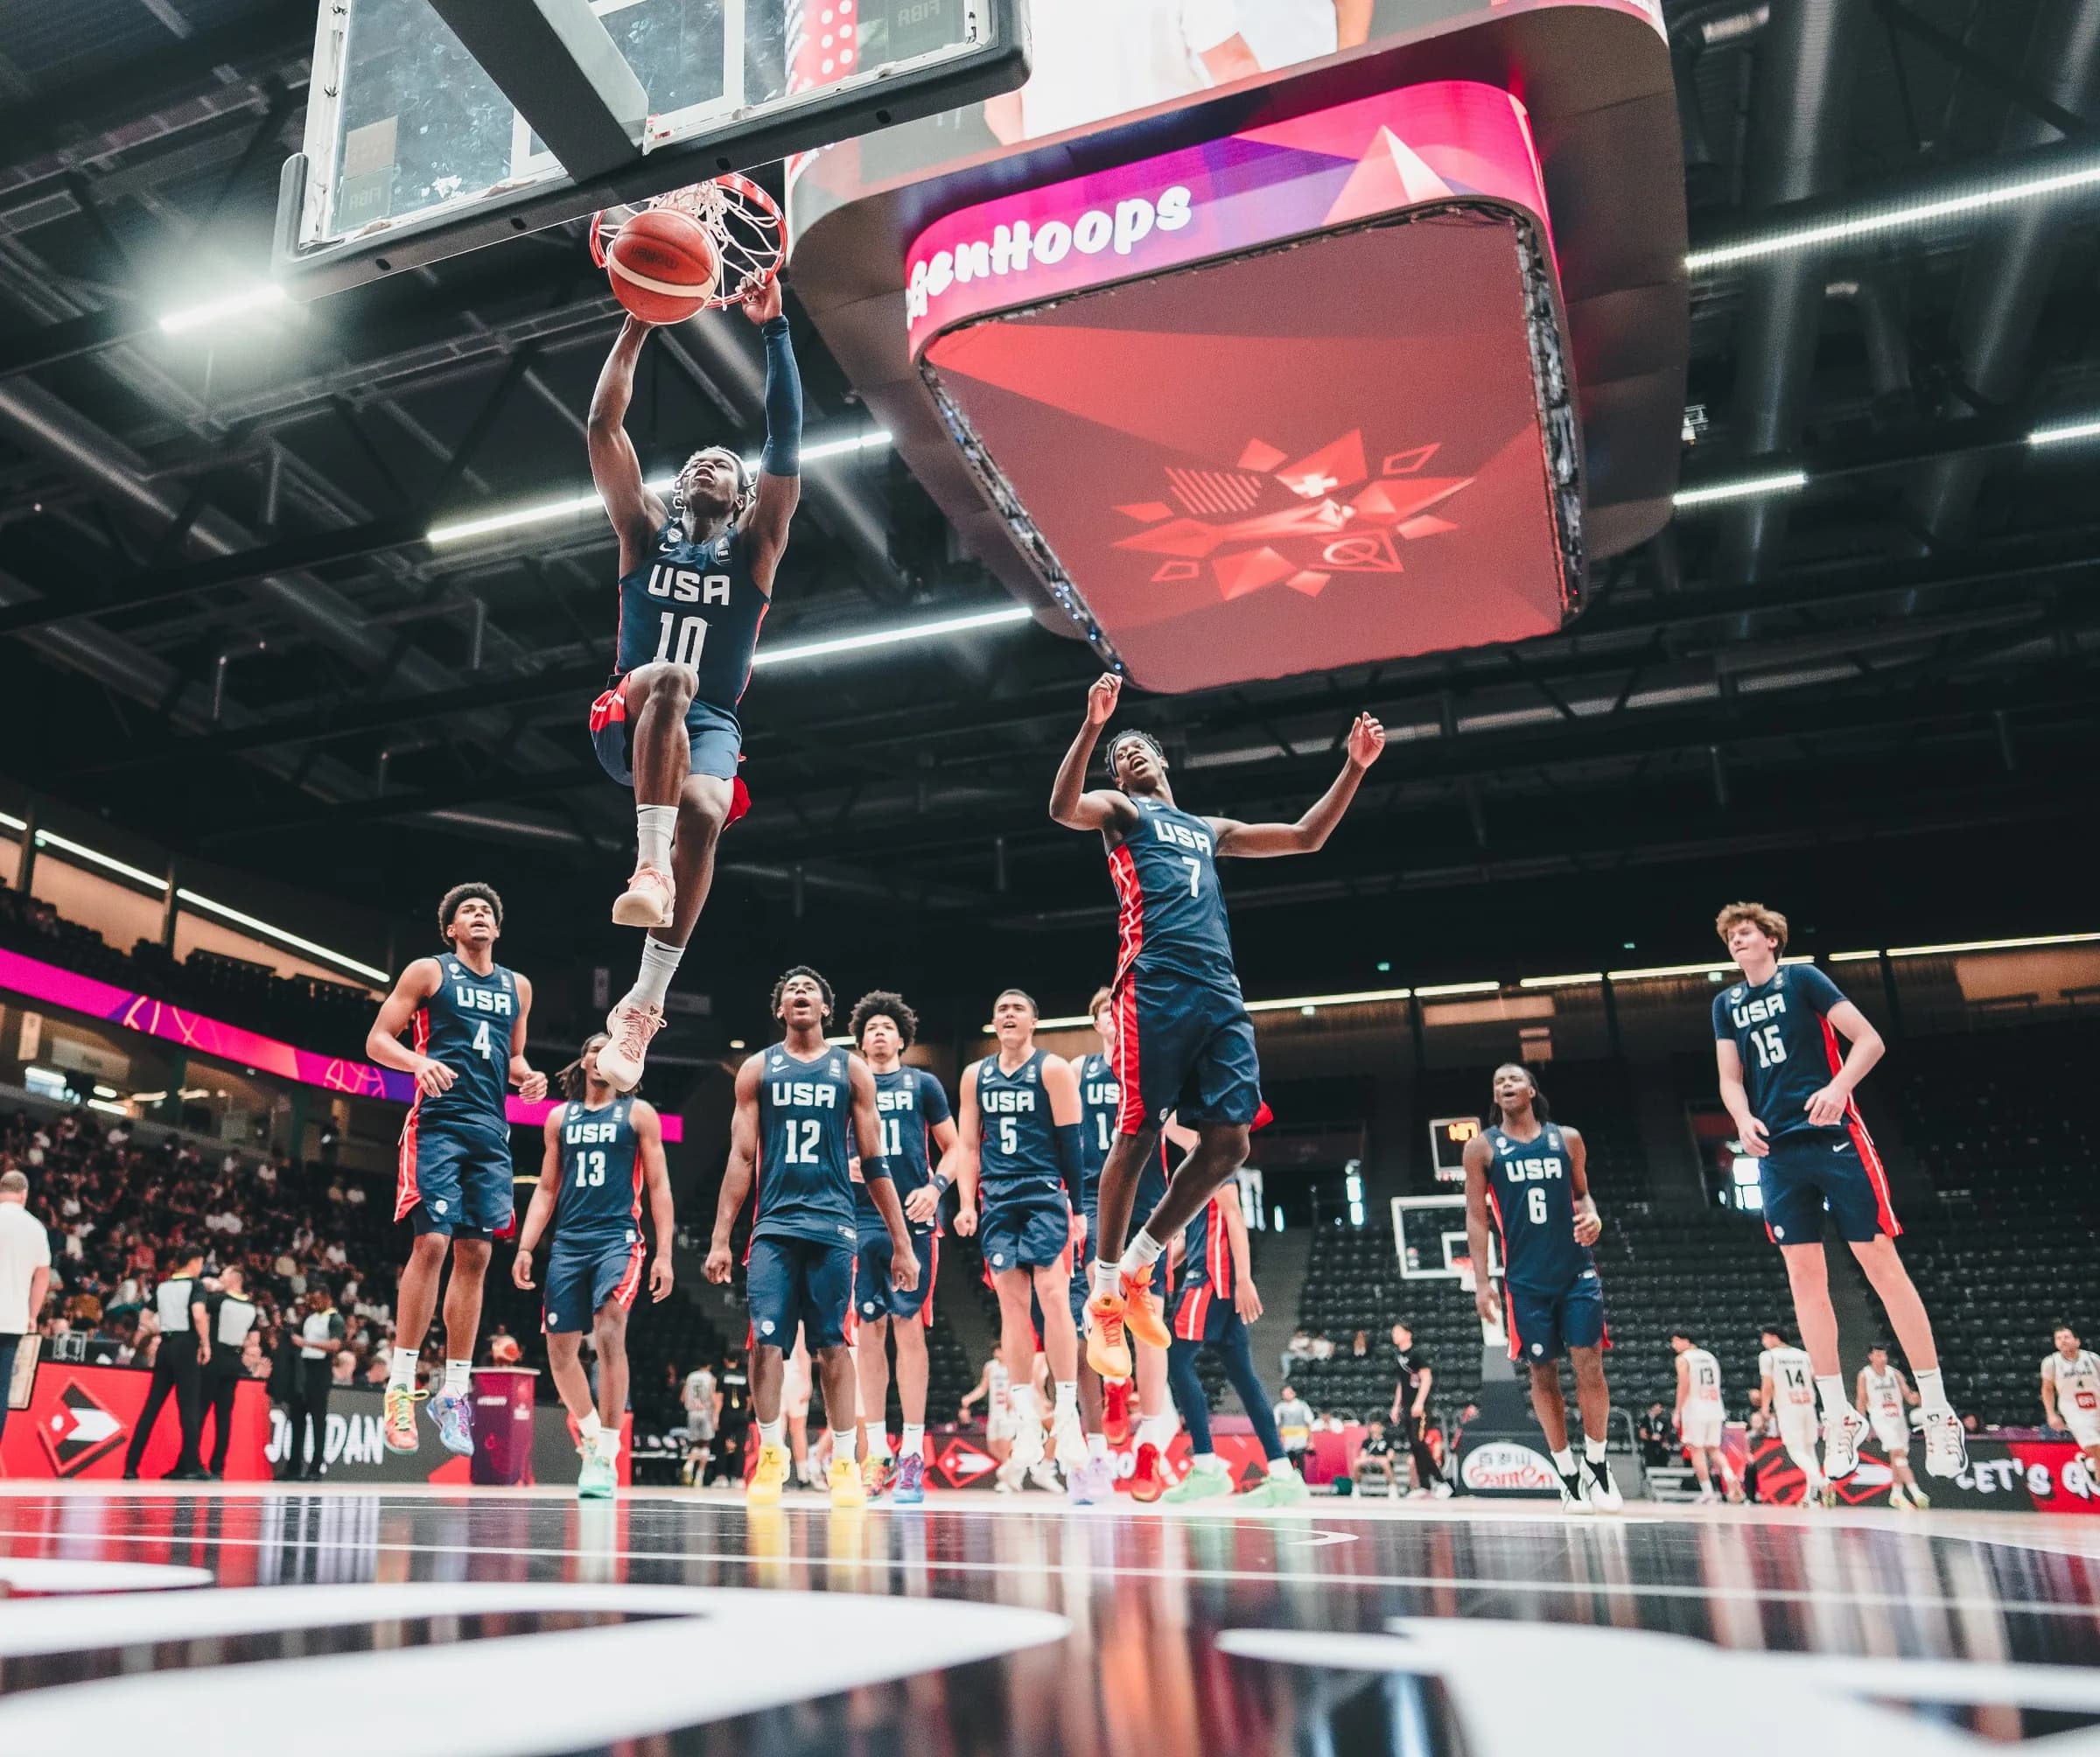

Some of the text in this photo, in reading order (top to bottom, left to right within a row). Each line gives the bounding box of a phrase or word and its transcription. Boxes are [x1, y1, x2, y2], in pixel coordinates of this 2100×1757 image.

[648, 564, 730, 606] USA
[653, 612, 708, 672] 10
[1154, 819, 1212, 858] USA
[1182, 856, 1200, 898] 7
[456, 986, 511, 1016] USA
[1732, 993, 1786, 1028] USA
[472, 1020, 492, 1060] 4
[1750, 1025, 1787, 1068] 15
[772, 1082, 836, 1109] USA
[876, 1091, 914, 1111] SA
[982, 1090, 1035, 1113] USA
[1087, 1083, 1120, 1105] US
[566, 1123, 617, 1144] USA
[785, 1119, 821, 1164] 12
[999, 1116, 1017, 1155] 5
[1096, 1112, 1117, 1151] 1
[576, 1151, 606, 1187] 13
[1505, 1158, 1562, 1182] USA
[1528, 1187, 1547, 1224] 6
[1700, 1367, 1714, 1385] 13
[1785, 1368, 1805, 1387] 14
